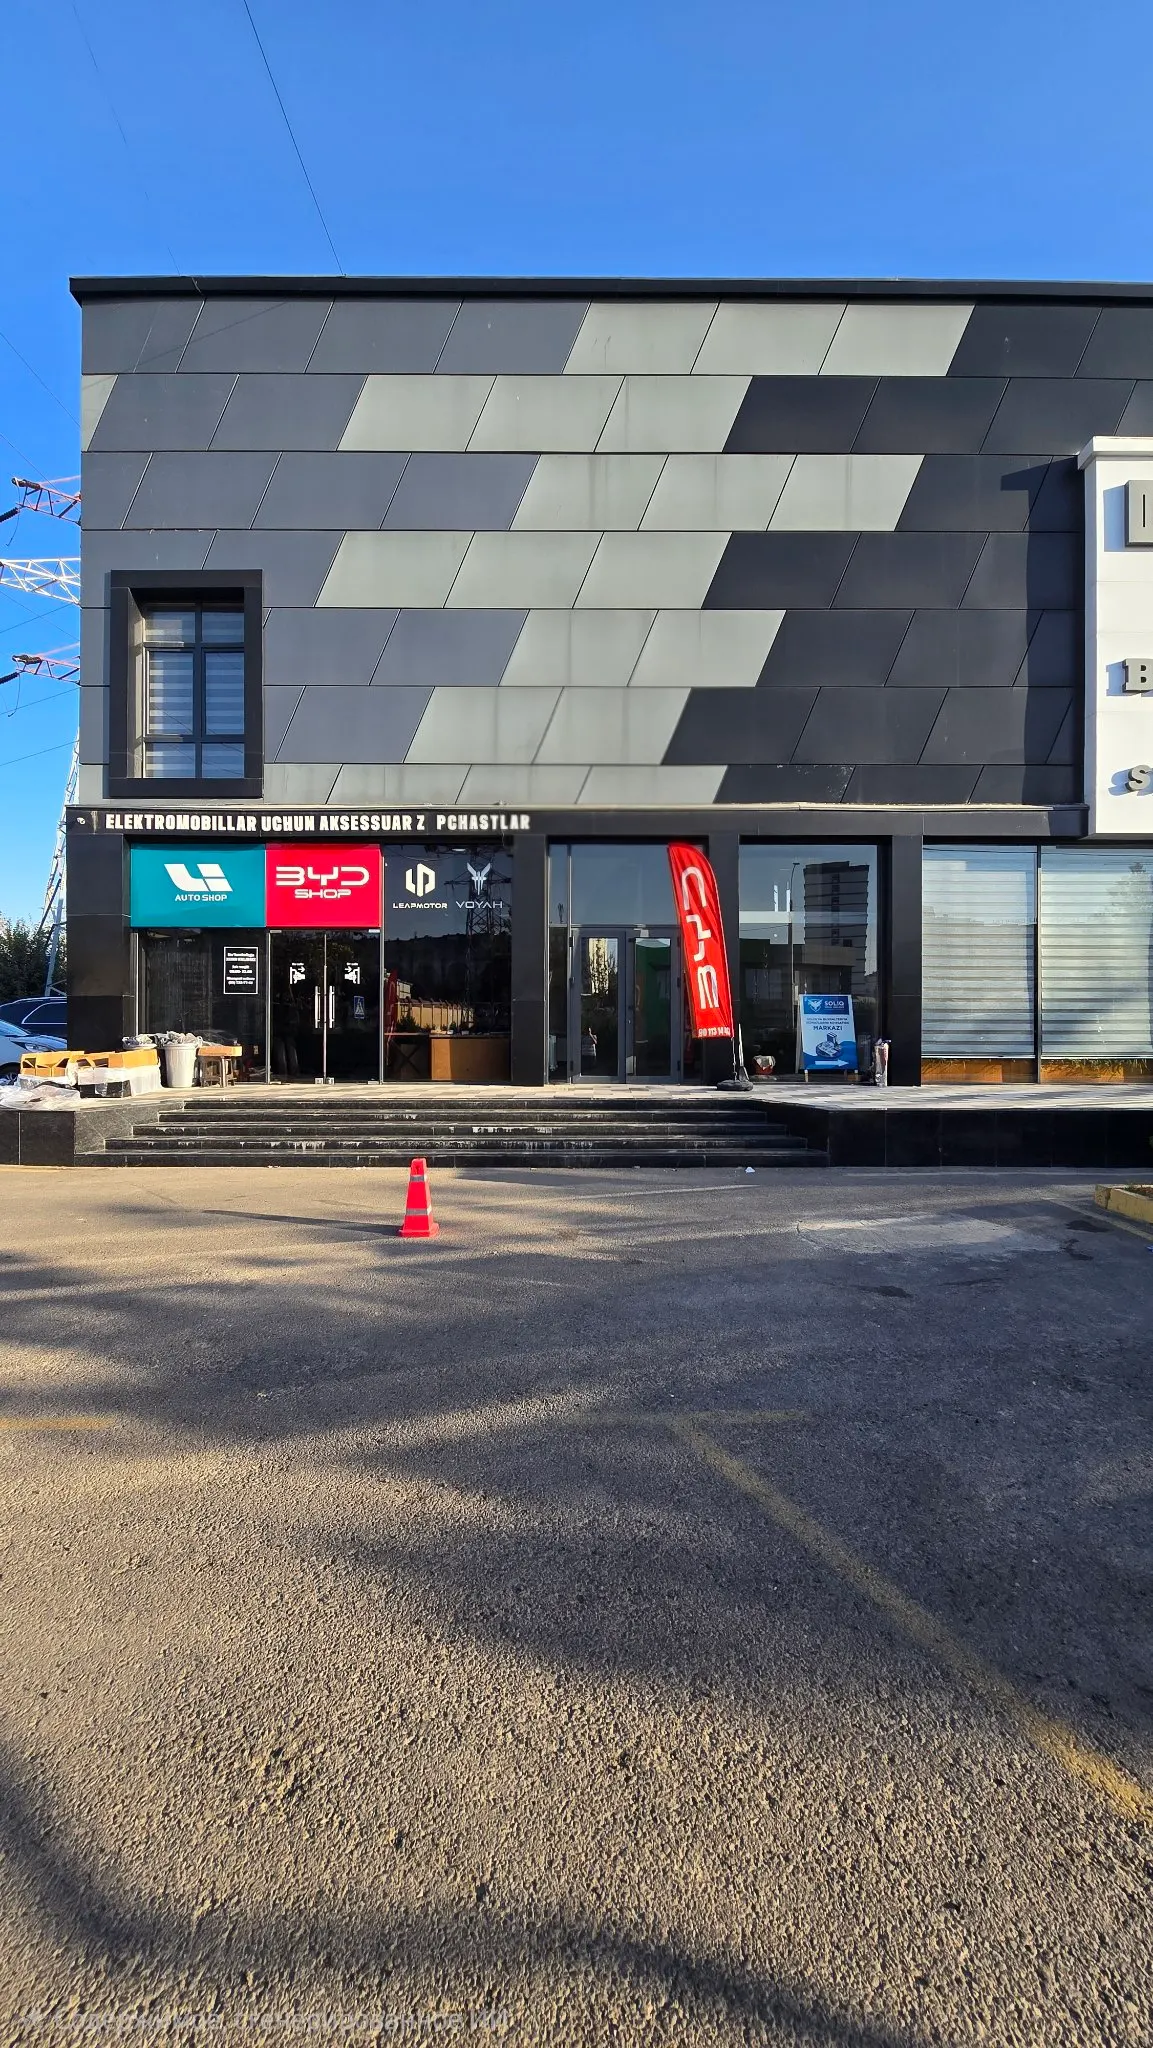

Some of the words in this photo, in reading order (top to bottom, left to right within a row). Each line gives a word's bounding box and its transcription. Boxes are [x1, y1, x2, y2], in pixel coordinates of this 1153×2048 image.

[105, 813, 257, 832] ELEKTROMOBILLAR
[261, 815, 315, 832] UCHUN
[319, 814, 412, 831] AKSESSUAR
[275, 866, 370, 886] BYD
[174, 894, 200, 902] AUTO
[202, 894, 228, 902] SHOP
[294, 888, 352, 899] SHOP
[456, 901, 503, 909] VOYAH
